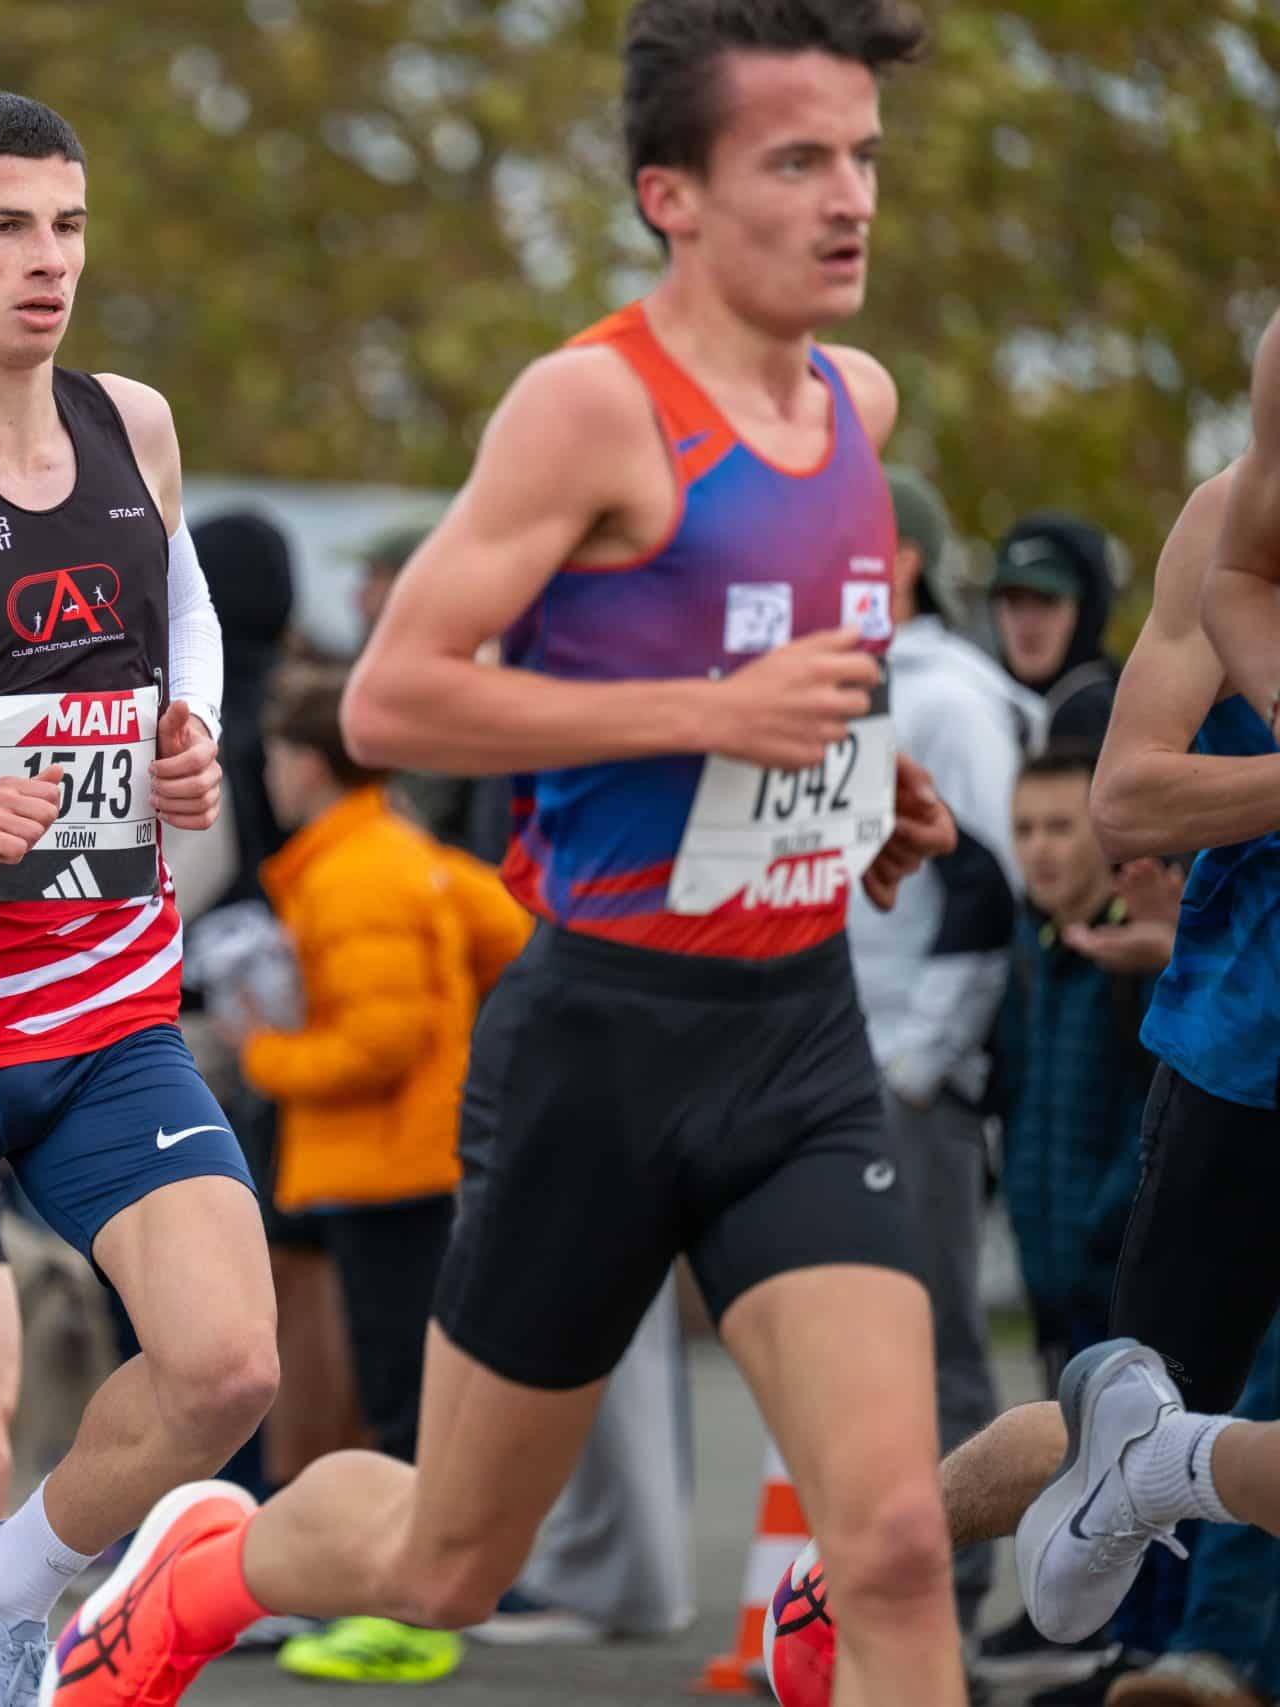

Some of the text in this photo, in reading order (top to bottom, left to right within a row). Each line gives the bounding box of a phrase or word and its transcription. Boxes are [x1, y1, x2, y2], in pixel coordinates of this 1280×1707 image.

[109, 507, 145, 519] START
[11, 646, 34, 657] CLUB
[34, 639, 78, 654] ATHLETIQUE
[79, 637, 91, 646] DU
[46, 698, 139, 737] MAIF
[55, 831, 97, 848] YOANN
[136, 823, 152, 844] U20
[742, 859, 849, 911] MAIF
